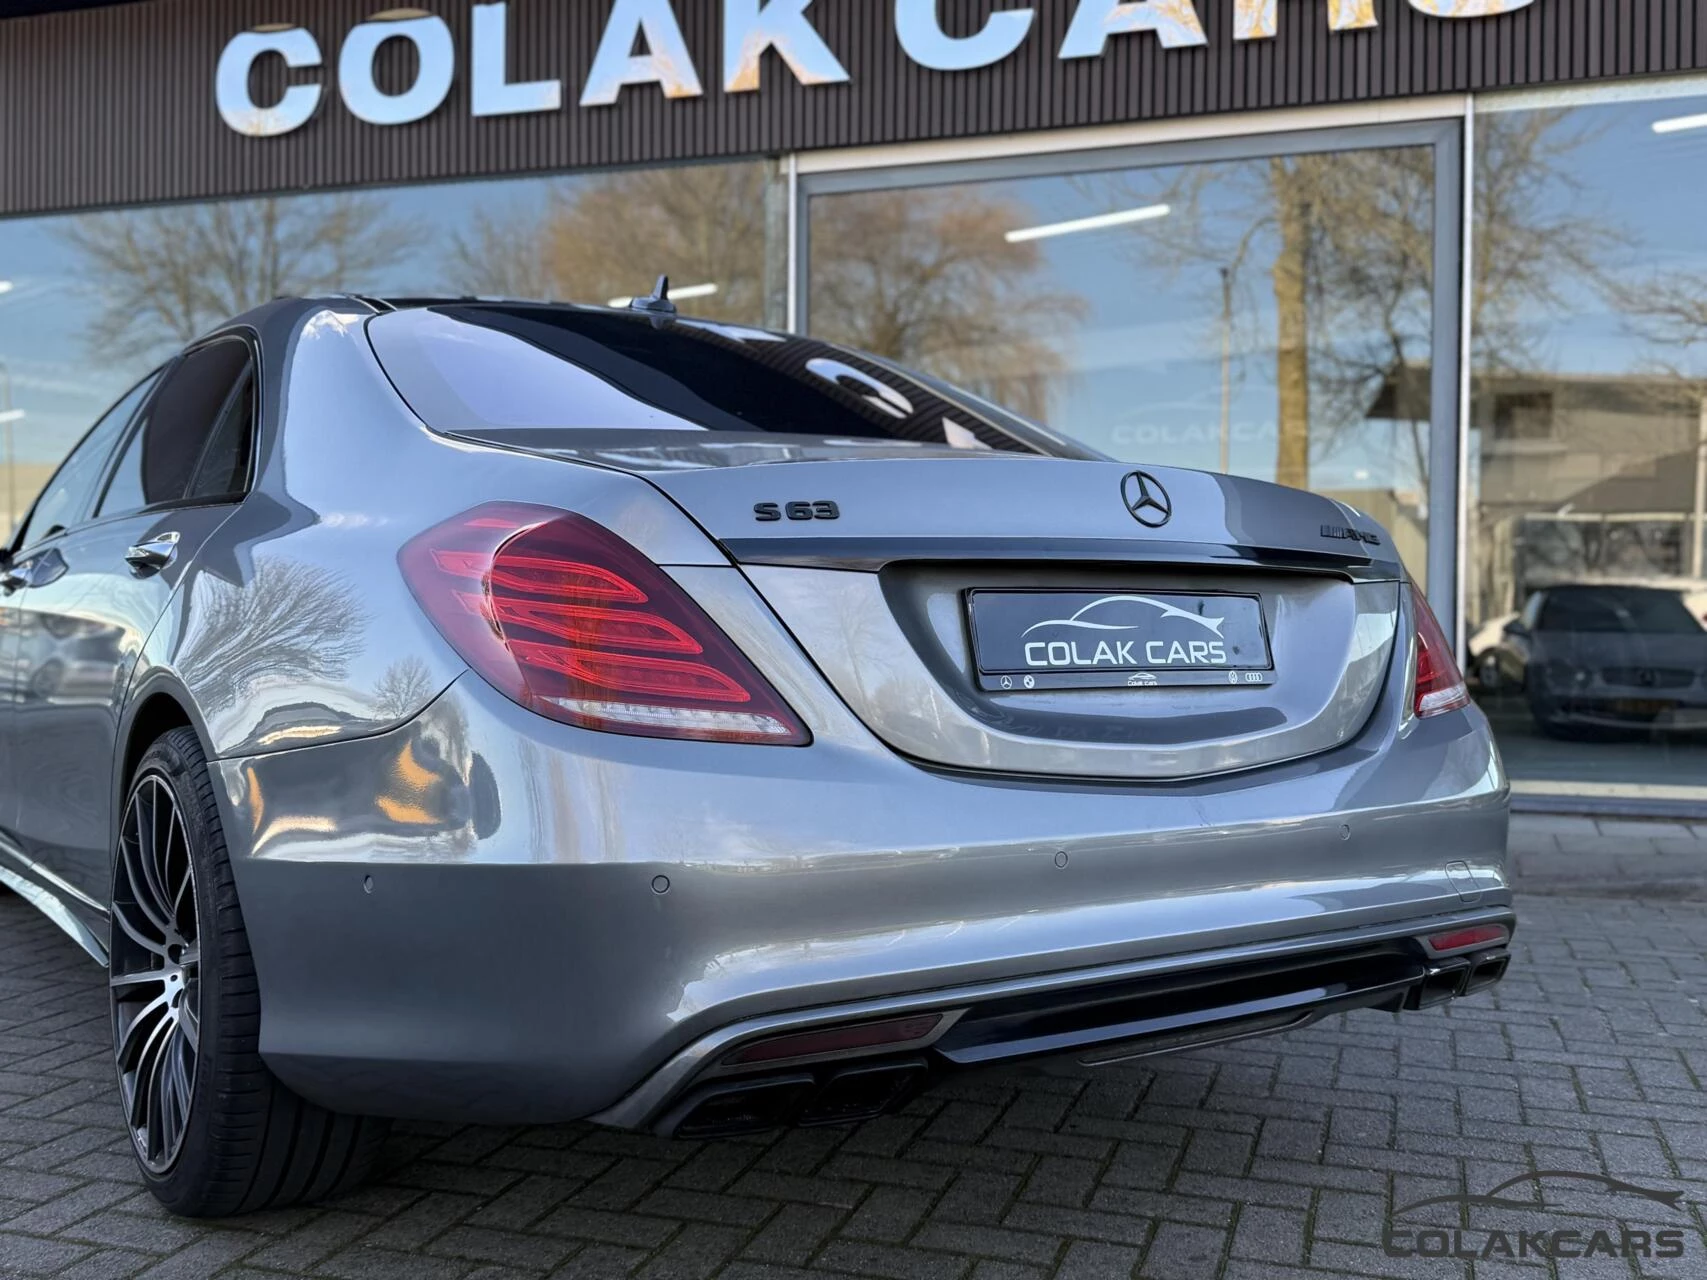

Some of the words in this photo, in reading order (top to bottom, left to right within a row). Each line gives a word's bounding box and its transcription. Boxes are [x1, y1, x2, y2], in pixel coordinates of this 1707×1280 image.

[214, 0, 851, 137] COLAK
[753, 502, 782, 522] S
[785, 500, 840, 521] 63
[1024, 640, 1138, 666] COLAK
[1145, 640, 1227, 664] CARS
